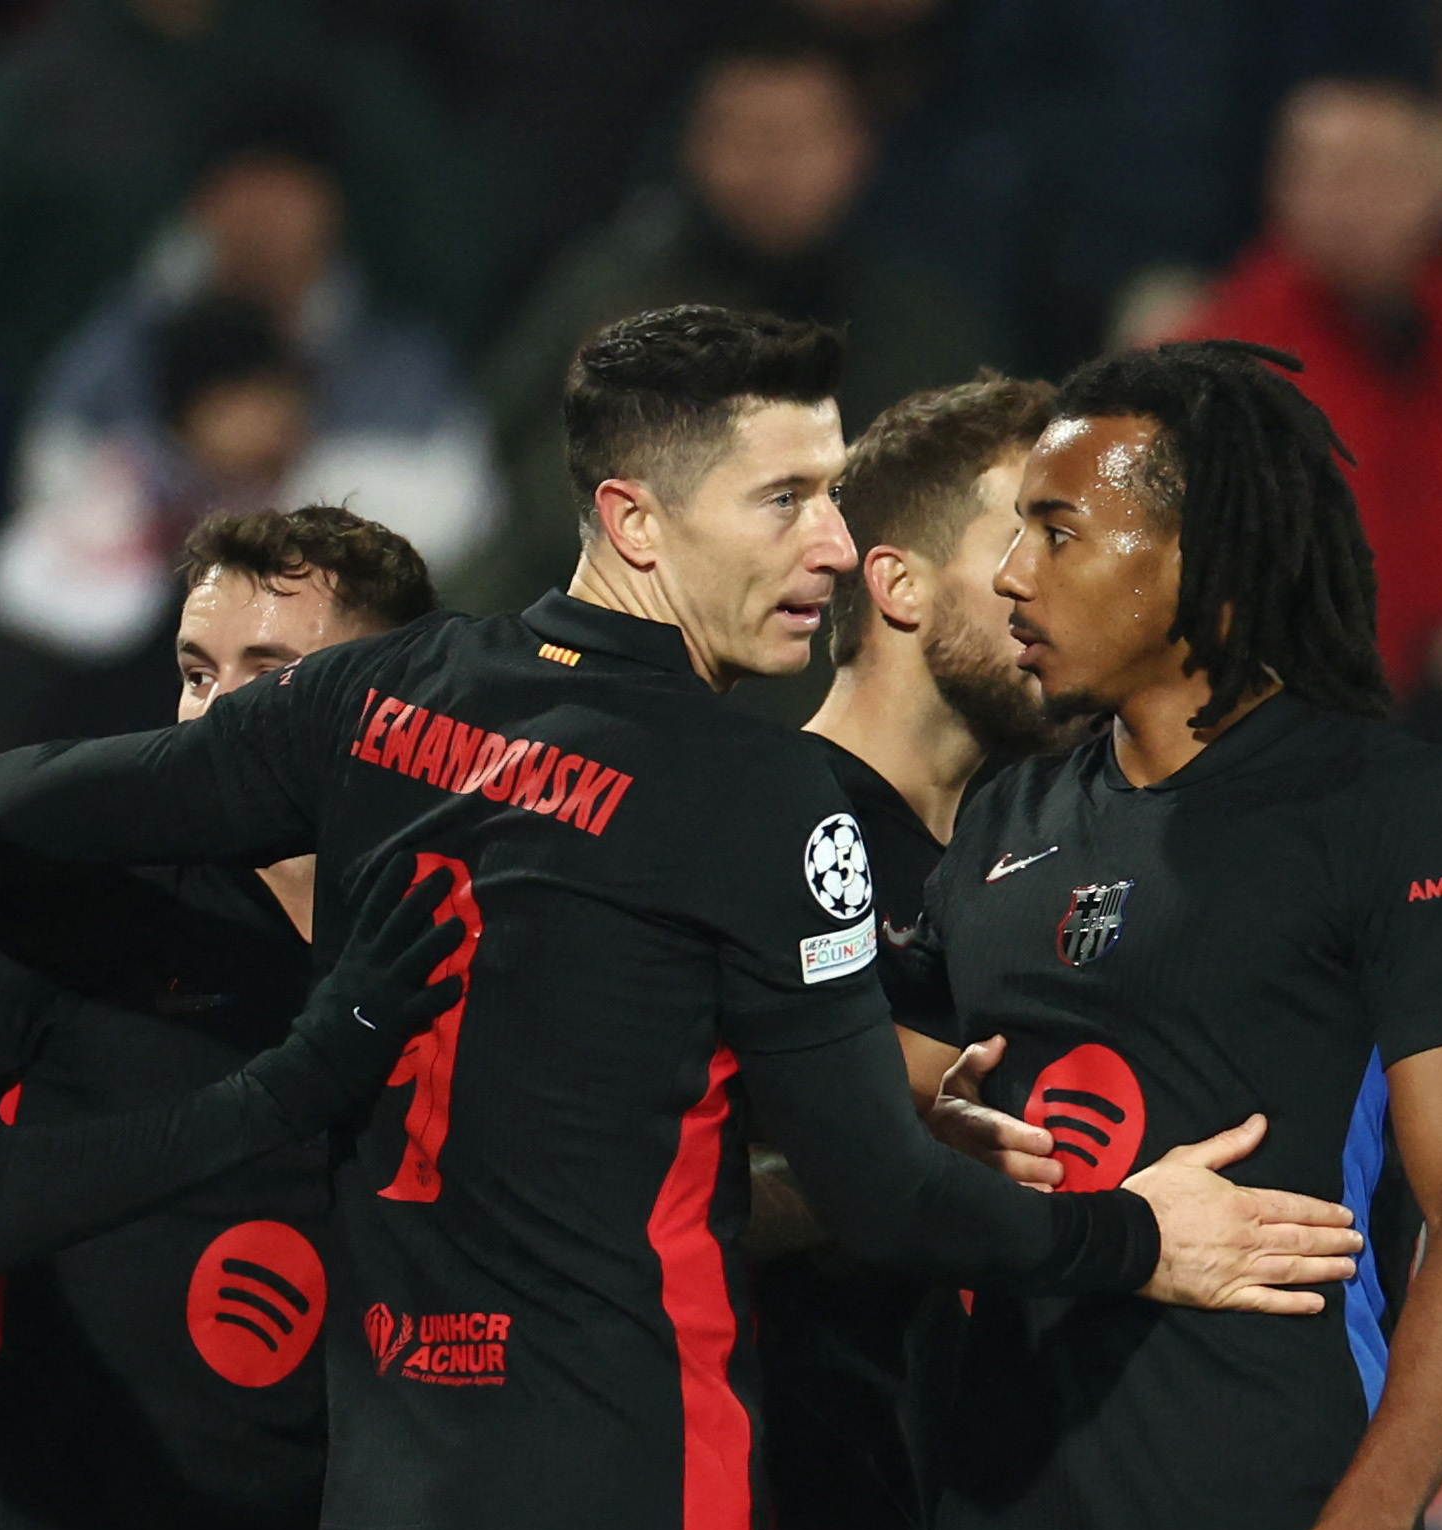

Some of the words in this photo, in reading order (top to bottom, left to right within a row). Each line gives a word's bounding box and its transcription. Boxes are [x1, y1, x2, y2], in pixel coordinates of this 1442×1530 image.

[836, 845, 855, 888] 5
[419, 1312, 512, 1344] UNHCR
[404, 1343, 505, 1373] ACNUR
